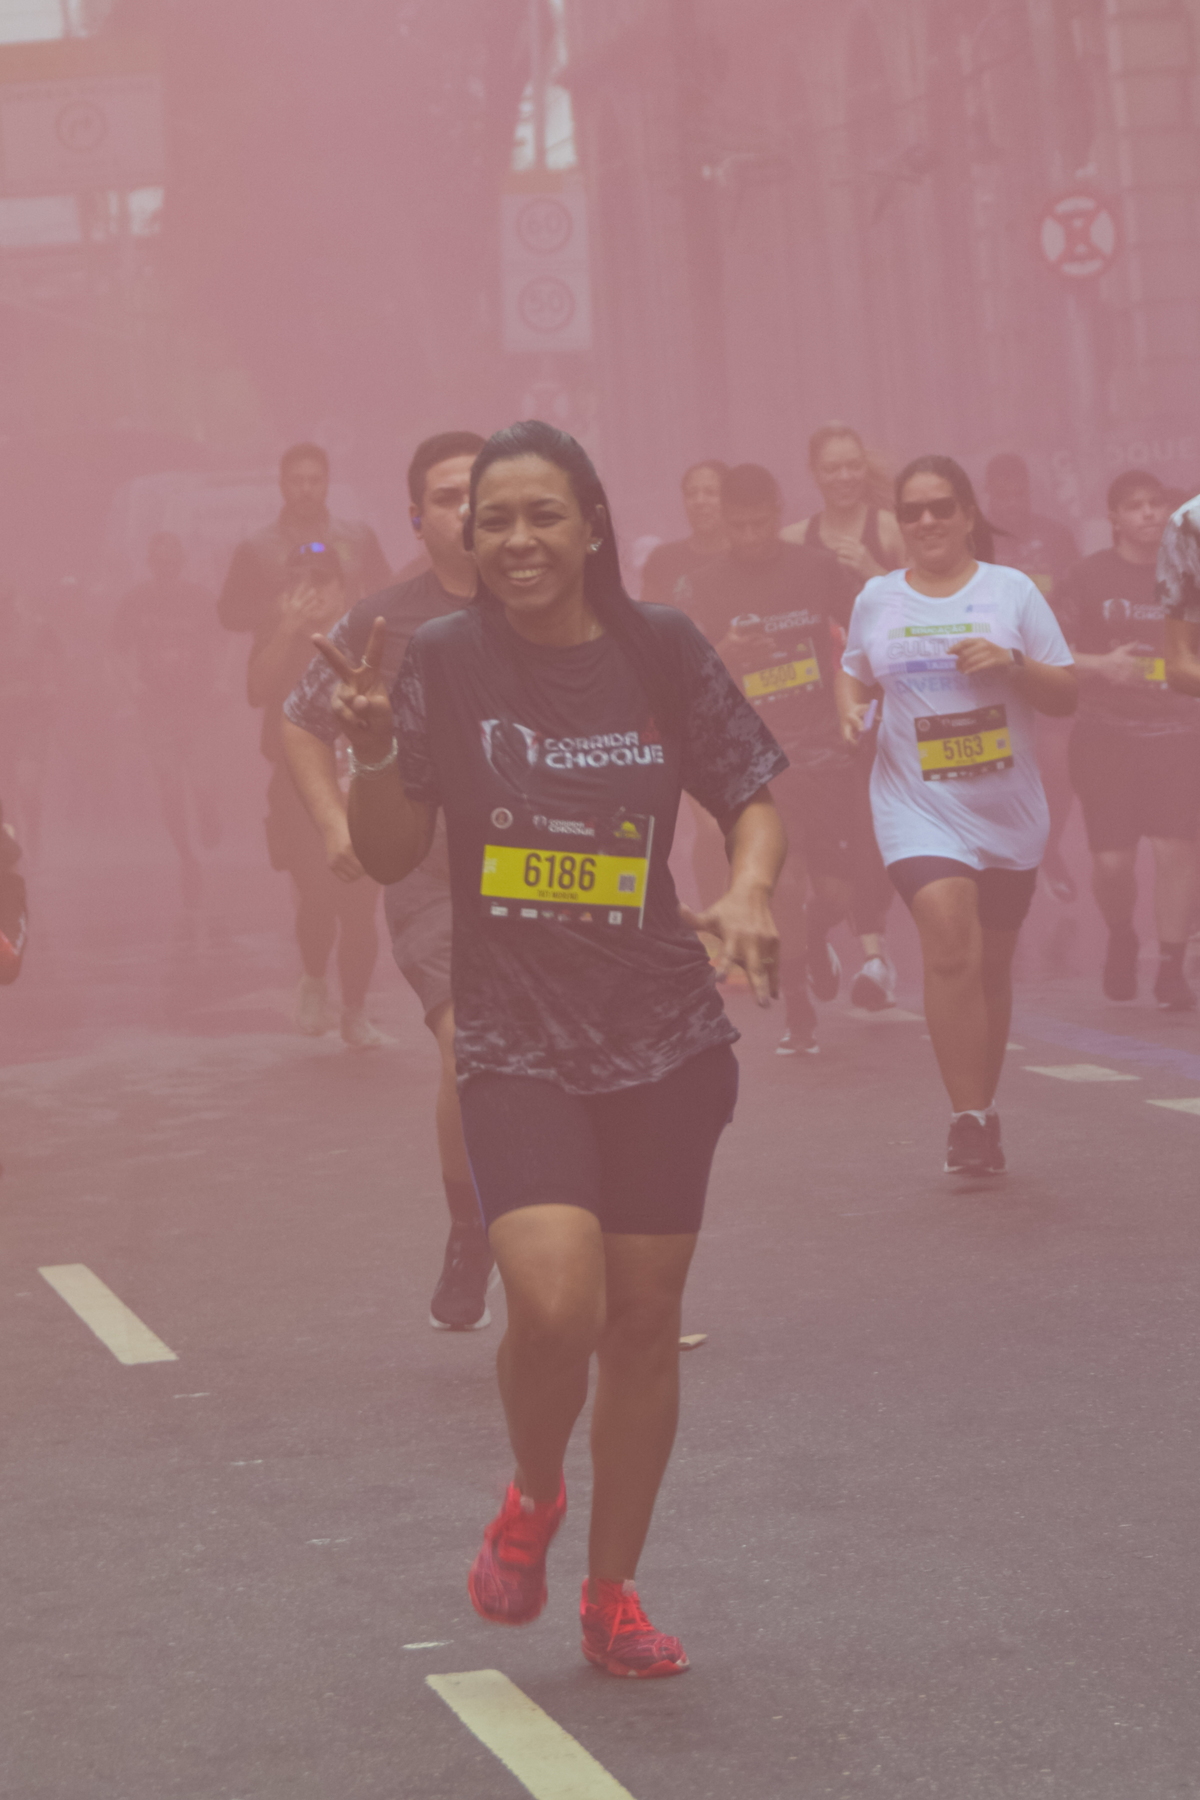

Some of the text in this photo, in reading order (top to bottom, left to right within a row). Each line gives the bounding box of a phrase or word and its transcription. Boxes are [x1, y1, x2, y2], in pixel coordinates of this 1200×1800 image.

[527, 211, 562, 235] 60
[528, 288, 565, 314] 50
[911, 624, 967, 637] EDUCAÇÃO
[544, 731, 640, 751] CORRIDA
[942, 734, 985, 761] 5163
[544, 744, 665, 769] CHOQUE
[523, 852, 597, 892] 6186
